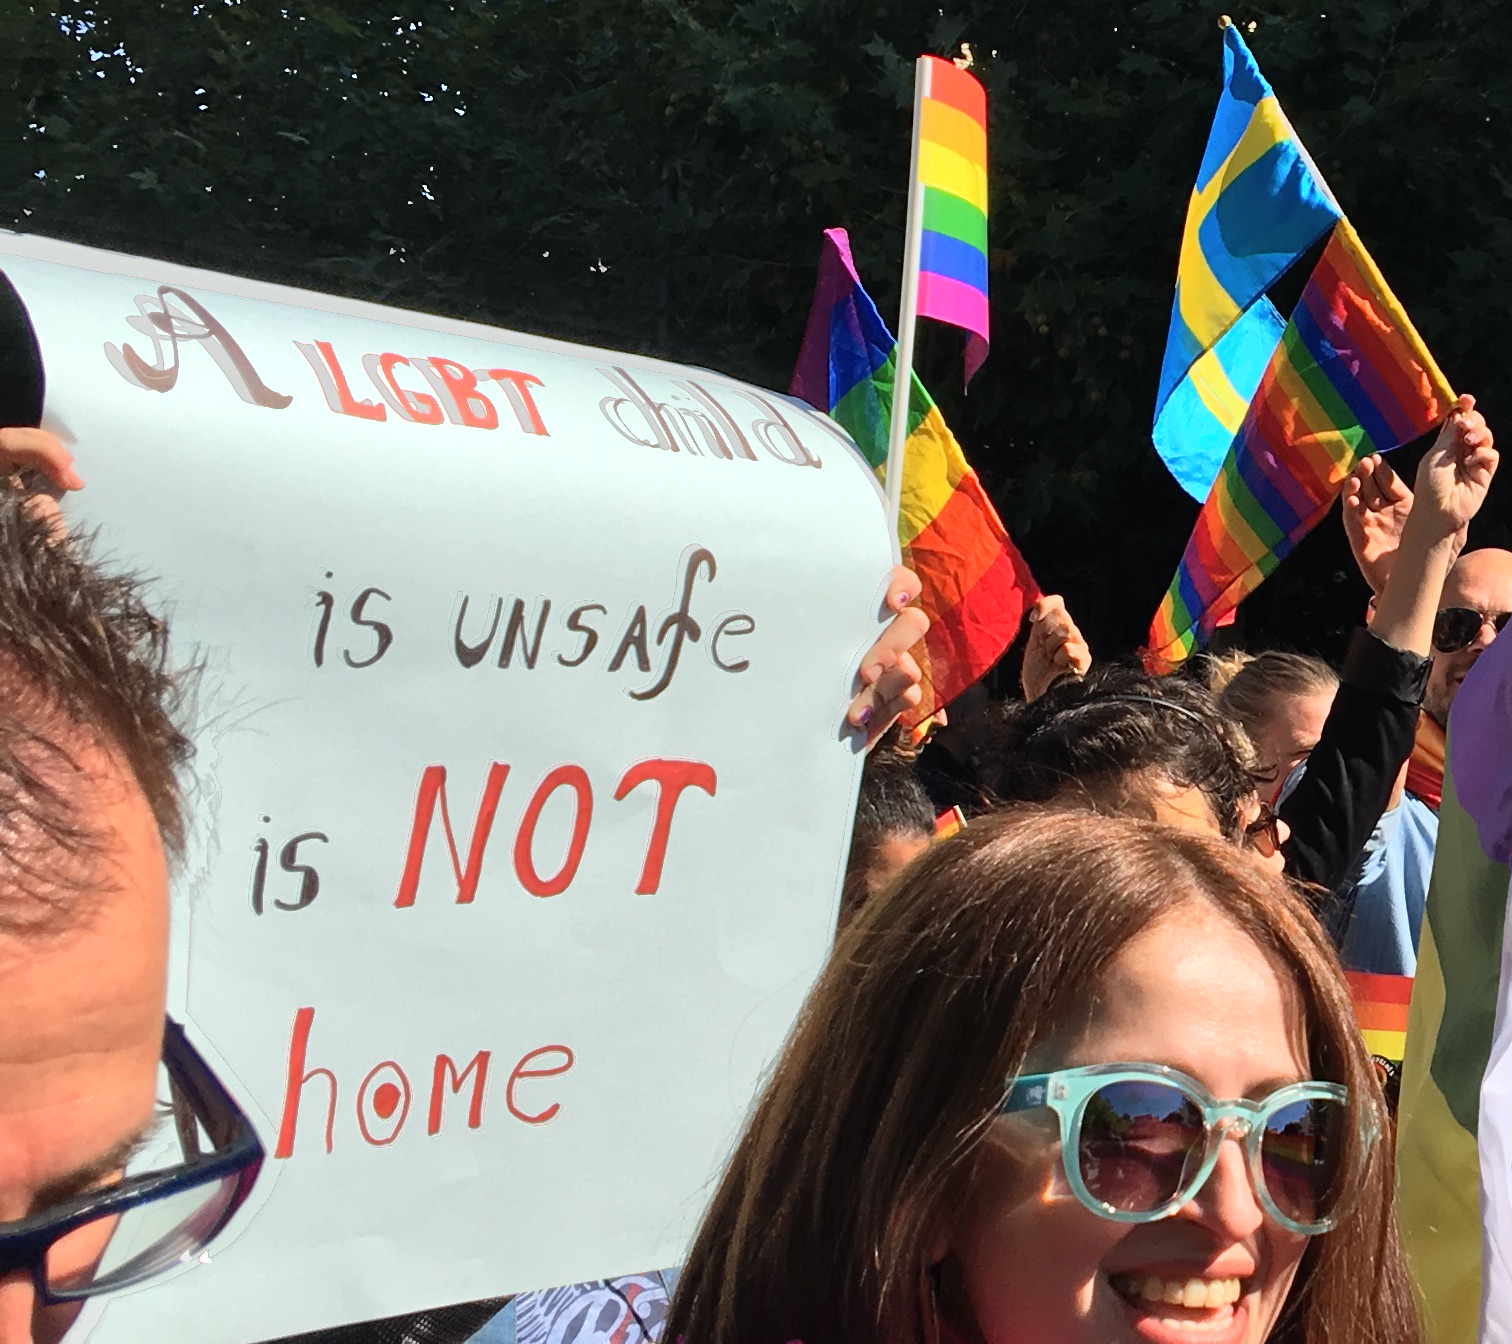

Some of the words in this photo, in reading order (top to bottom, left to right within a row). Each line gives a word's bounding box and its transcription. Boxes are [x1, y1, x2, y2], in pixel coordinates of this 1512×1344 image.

[103, 285, 294, 410] A
[294, 339, 551, 438] LGBT
[594, 366, 823, 469] child
[313, 570, 394, 670] is
[250, 814, 329, 916] is
[393, 759, 718, 909] NOT
